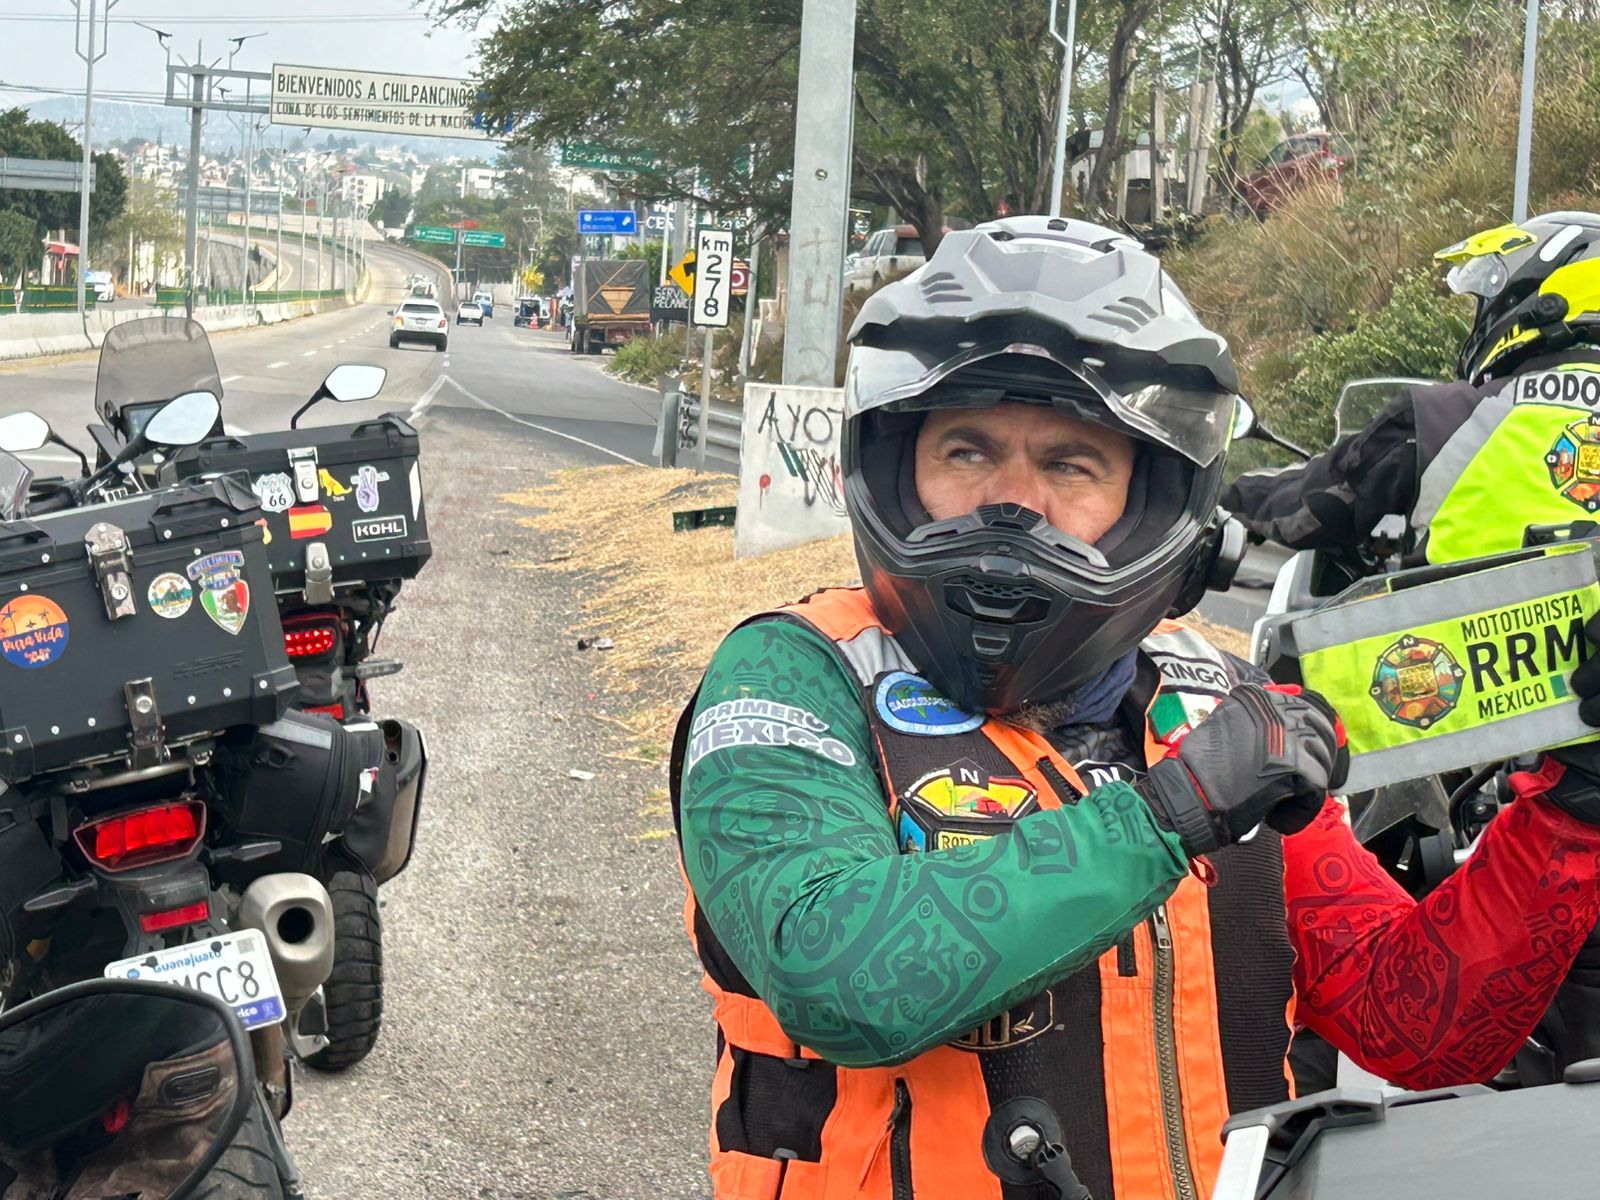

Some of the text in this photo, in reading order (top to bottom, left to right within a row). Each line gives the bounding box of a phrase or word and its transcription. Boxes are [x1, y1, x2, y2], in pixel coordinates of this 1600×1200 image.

[277, 73, 362, 99] BIENVENIDOS
[367, 84, 377, 99] A
[321, 106, 338, 119] LOS
[702, 237, 729, 251] km
[703, 254, 723, 317] 278
[269, 493, 287, 507] 66
[356, 522, 403, 538] KOHL
[1461, 594, 1583, 642] MOTOTURISTA
[1466, 617, 1588, 694] RRM
[1478, 683, 1547, 719] MÉXICO
